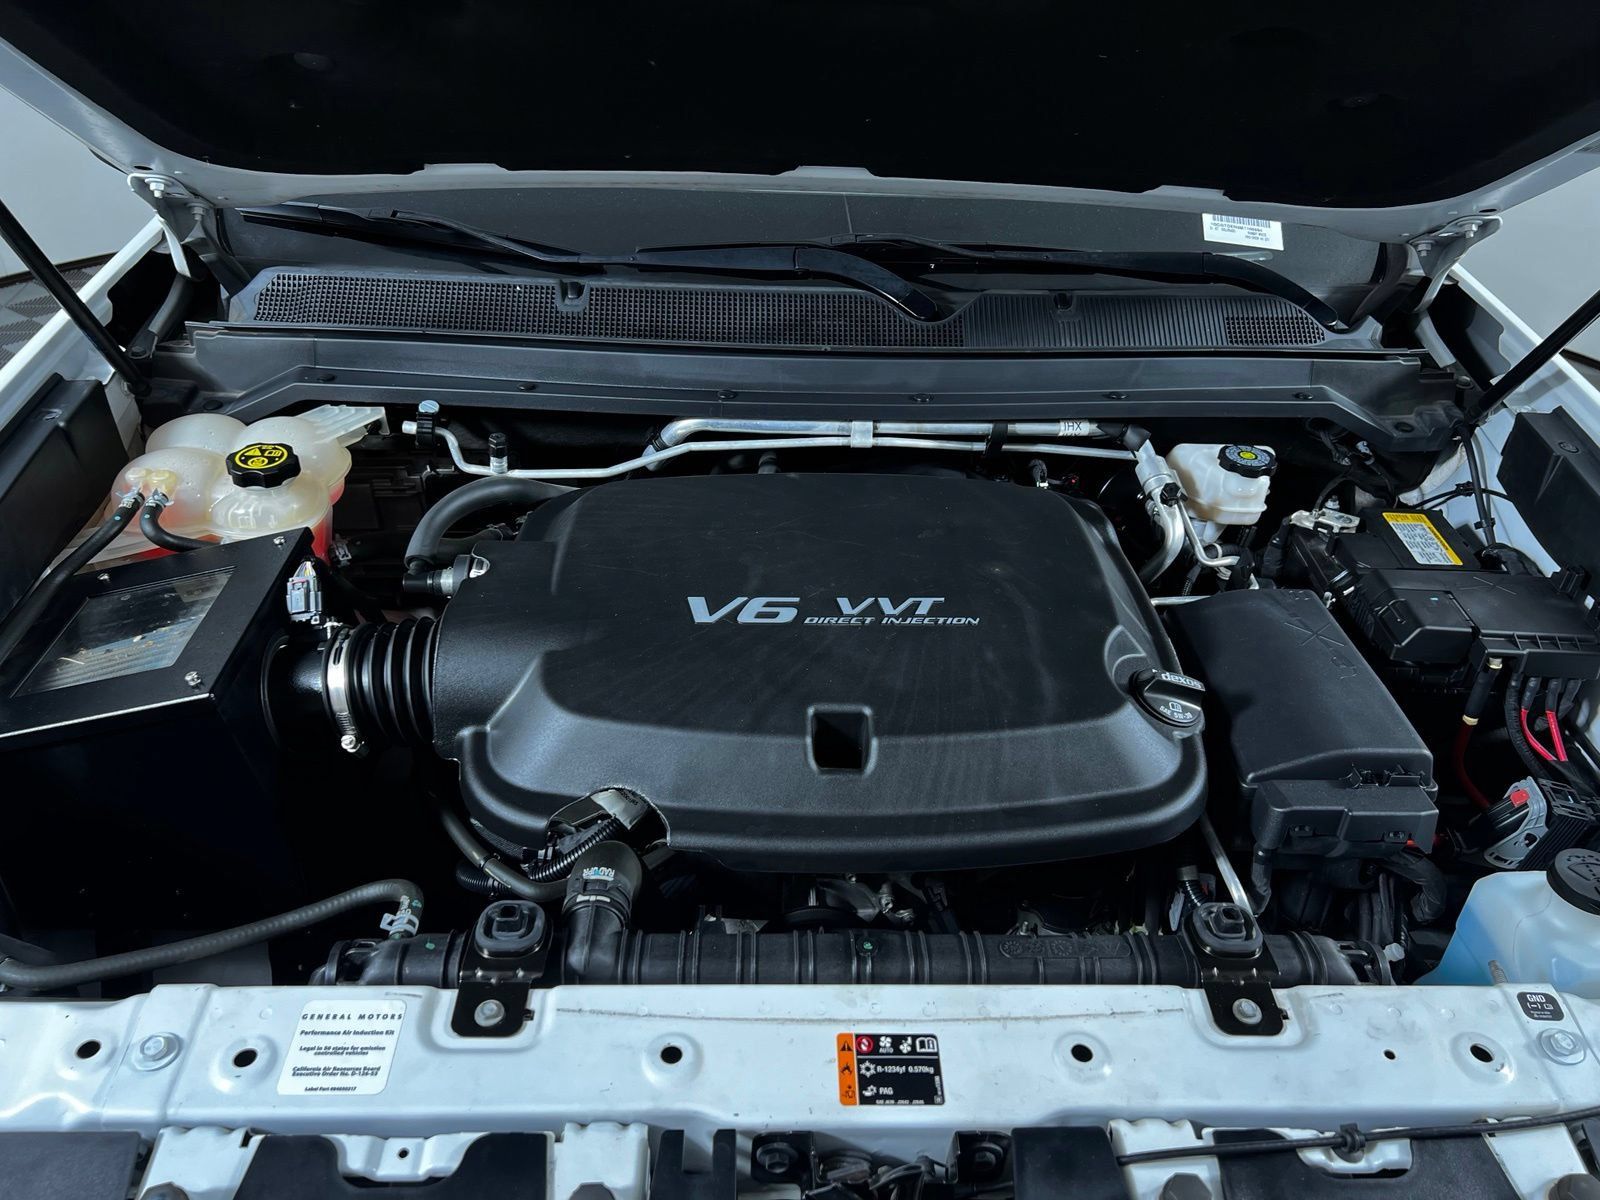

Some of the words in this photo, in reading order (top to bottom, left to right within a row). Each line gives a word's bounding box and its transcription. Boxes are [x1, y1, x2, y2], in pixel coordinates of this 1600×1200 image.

[687, 596, 801, 624] V6
[836, 597, 945, 615] VVT
[803, 617, 876, 625] DIRECT
[881, 617, 980, 625] INJECTION
[1161, 671, 1202, 689] dexos
[1526, 994, 1546, 1002] GND
[876, 1065, 906, 1075] R-1234yf
[879, 1087, 893, 1095] PAG
